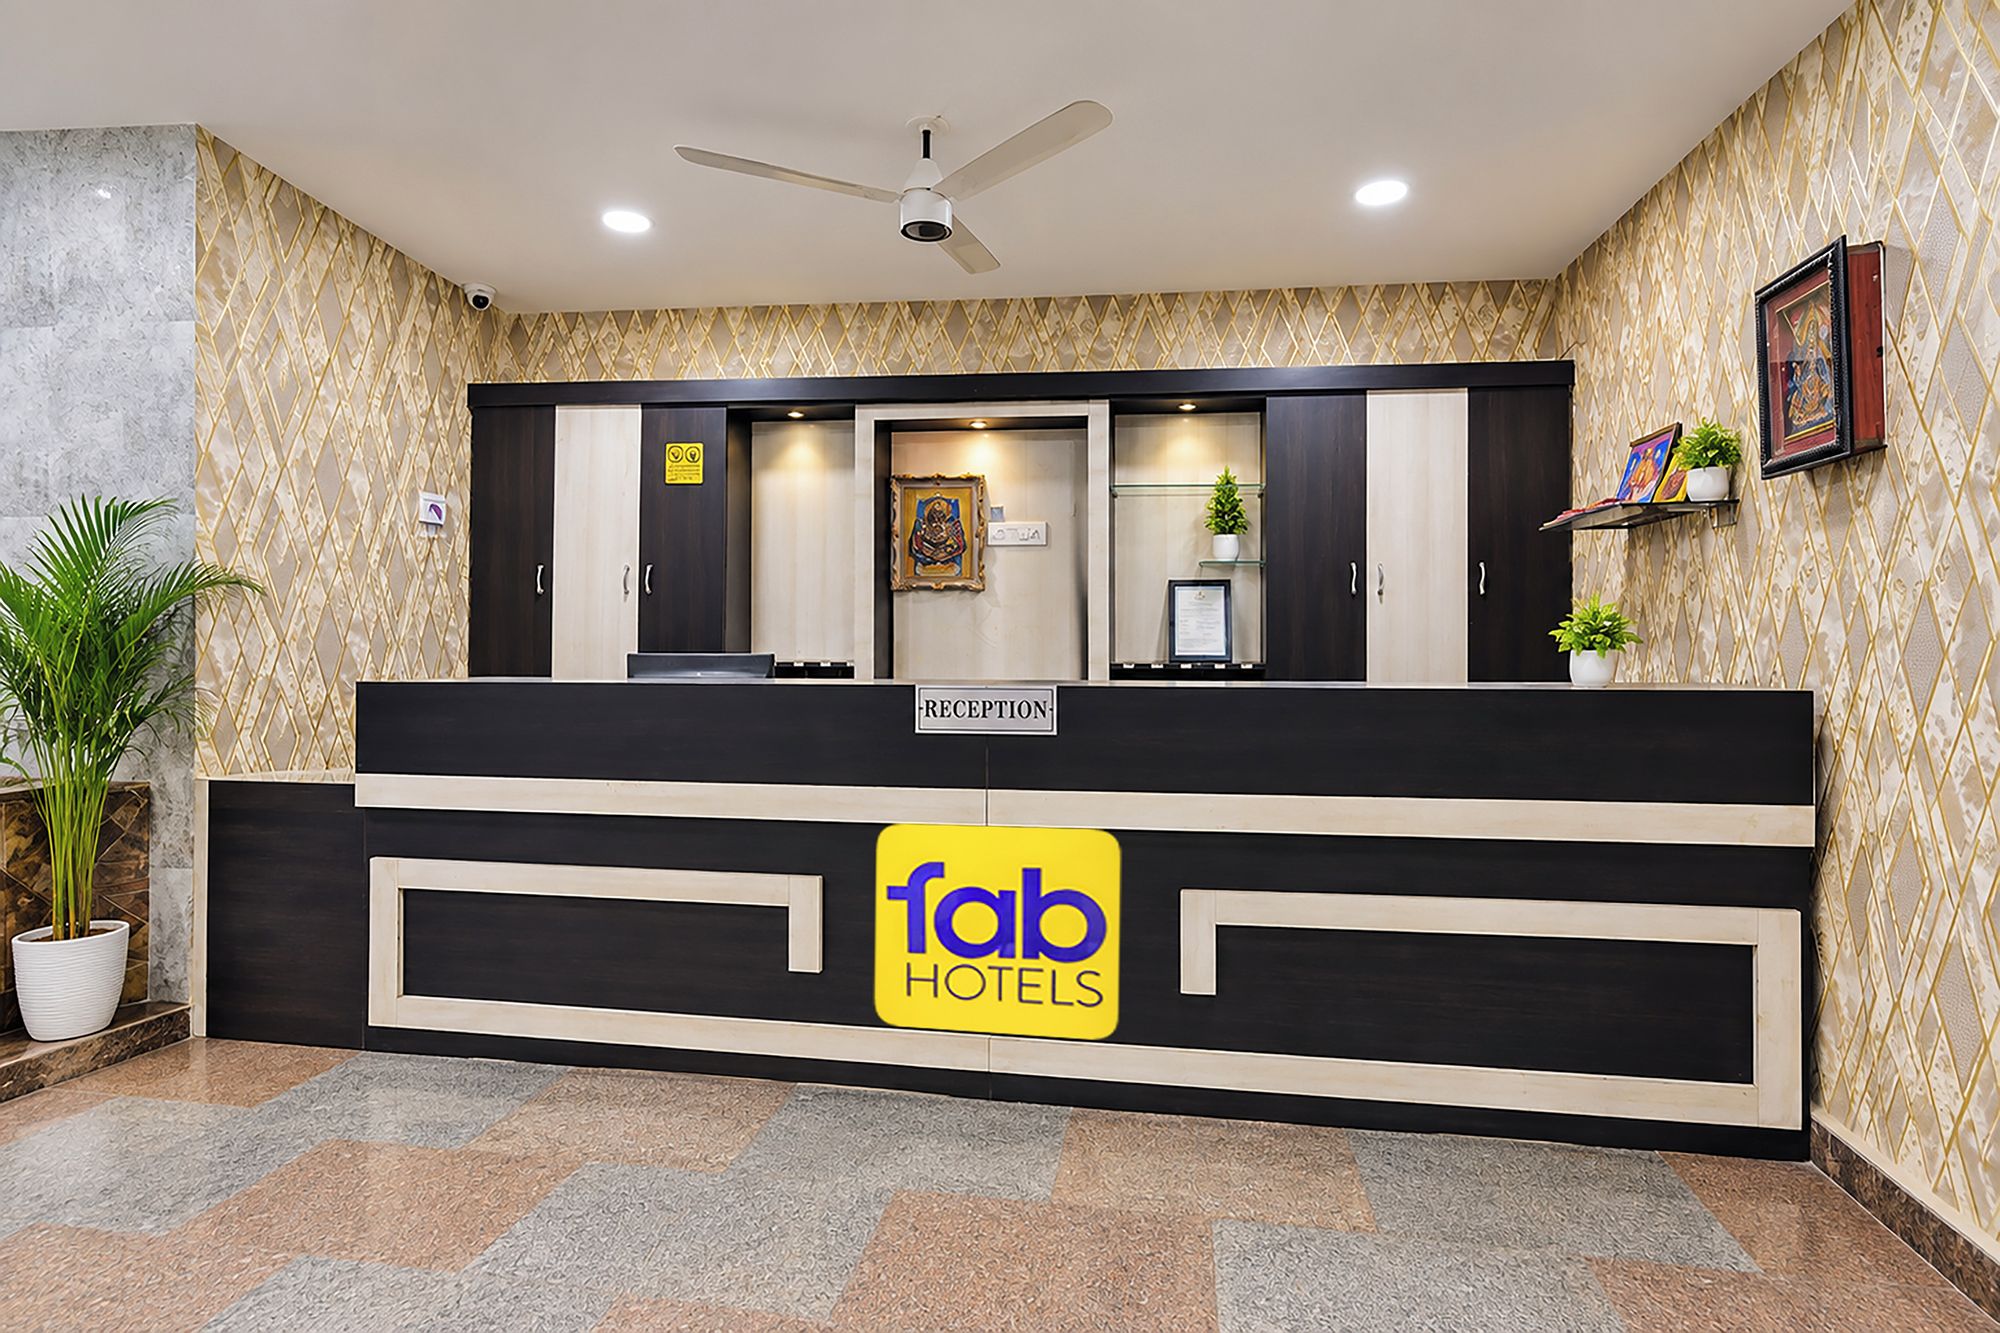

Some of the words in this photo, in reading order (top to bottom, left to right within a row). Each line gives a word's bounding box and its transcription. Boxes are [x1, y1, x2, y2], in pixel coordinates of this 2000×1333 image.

[924, 699, 1048, 719] RECEPTION
[886, 861, 1107, 963] fab
[906, 962, 1104, 1008] HOTELS
